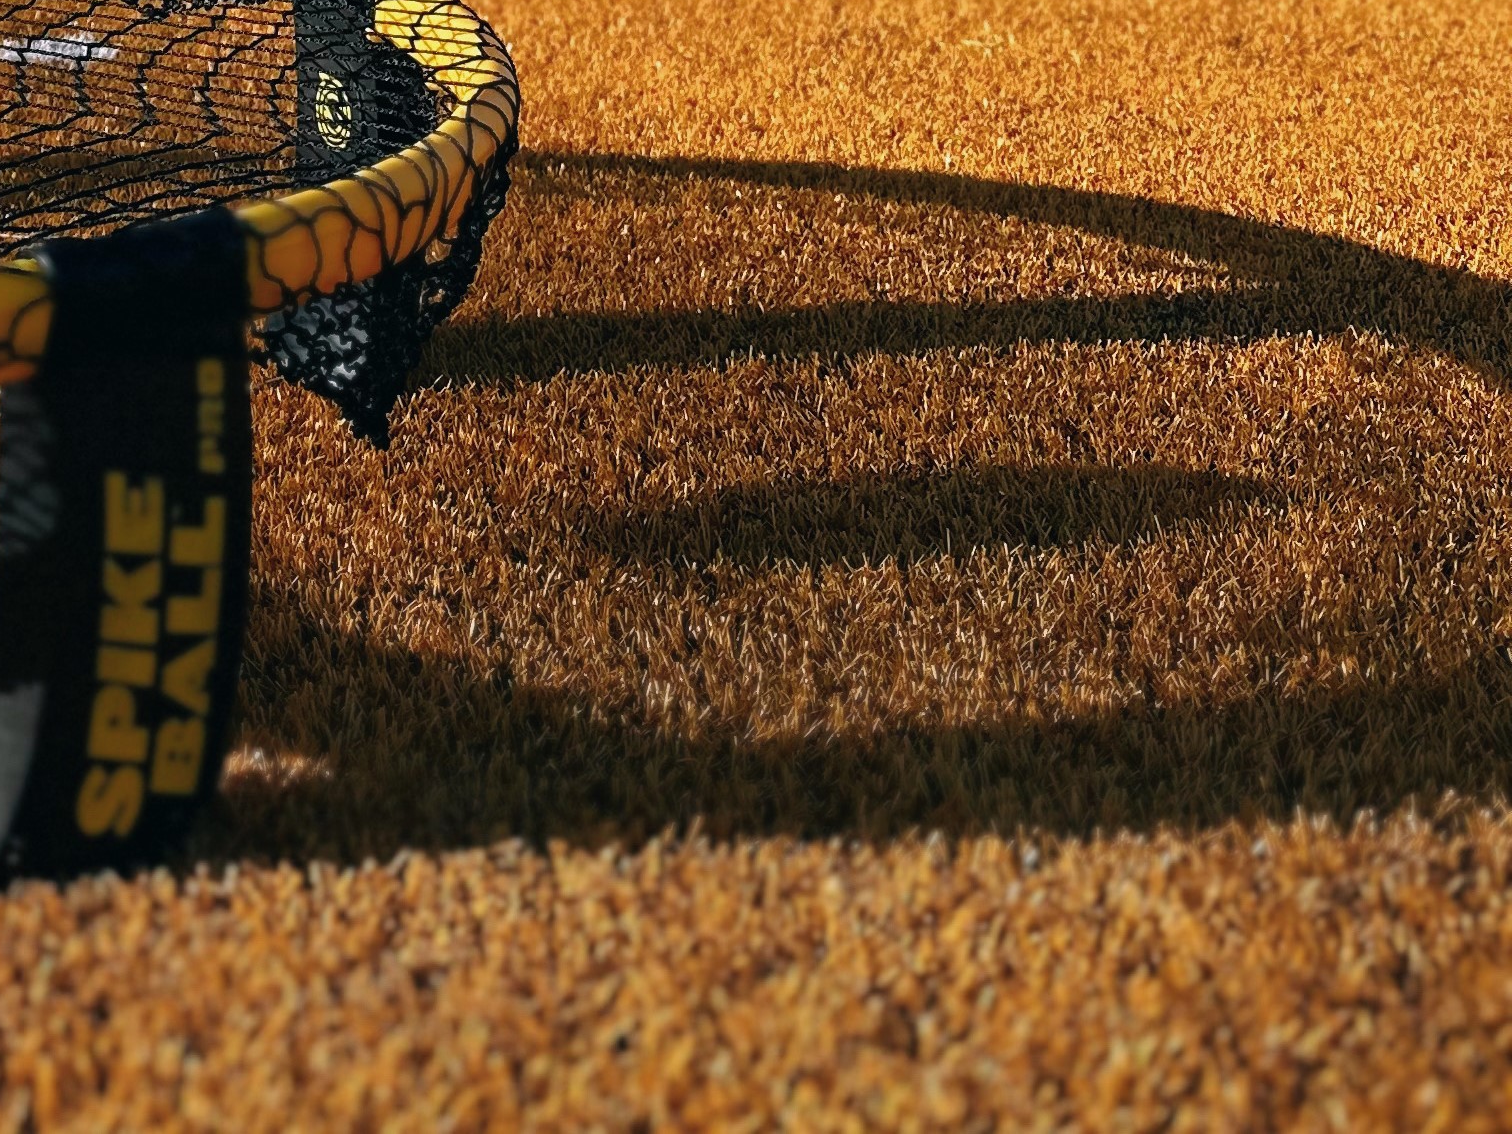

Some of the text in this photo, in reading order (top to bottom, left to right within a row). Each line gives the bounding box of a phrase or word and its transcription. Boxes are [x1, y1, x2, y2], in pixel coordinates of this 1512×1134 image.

[76, 470, 164, 838] SPIKE
[149, 358, 226, 794] BALL PRO
